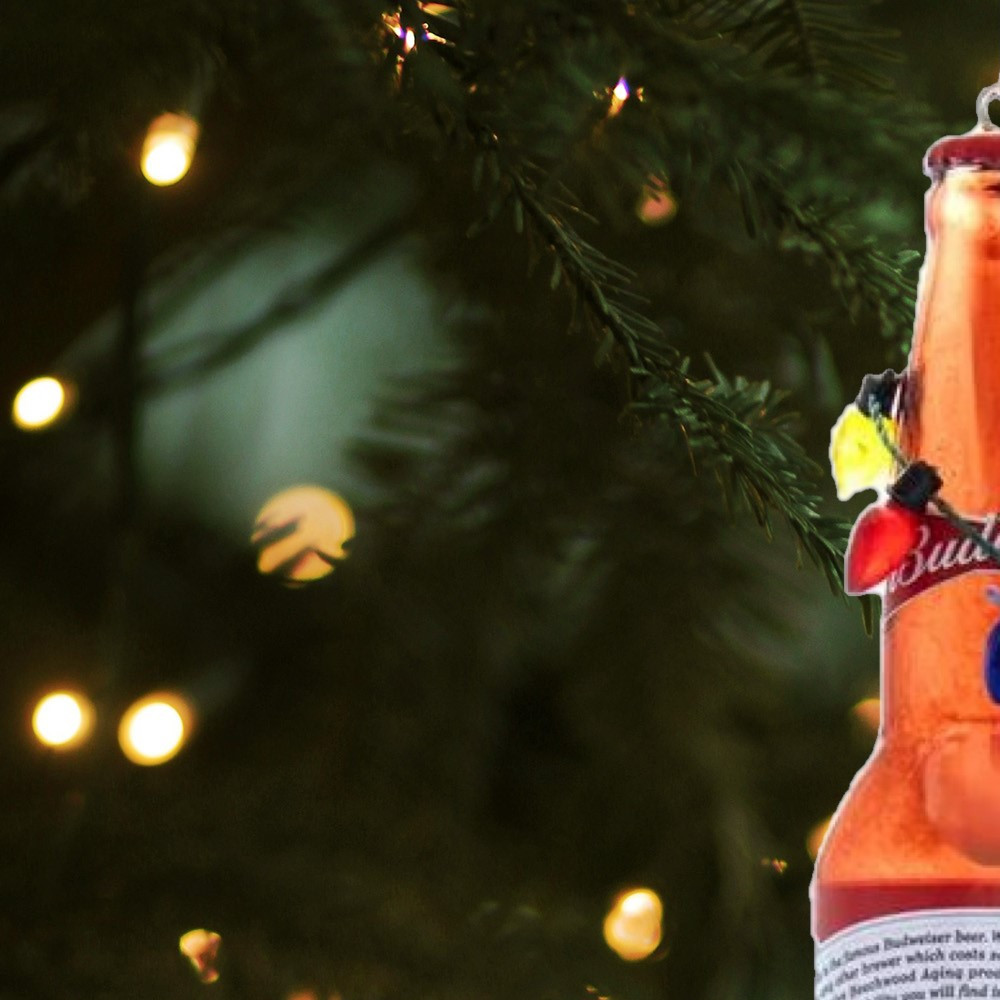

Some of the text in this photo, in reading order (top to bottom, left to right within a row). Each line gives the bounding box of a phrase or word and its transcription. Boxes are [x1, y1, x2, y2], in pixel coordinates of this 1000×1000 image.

[956, 929, 988, 943] beer.
[907, 949, 944, 964] which
[949, 949, 985, 961] costs
[930, 985, 954, 998] will
[959, 984, 988, 999] find
